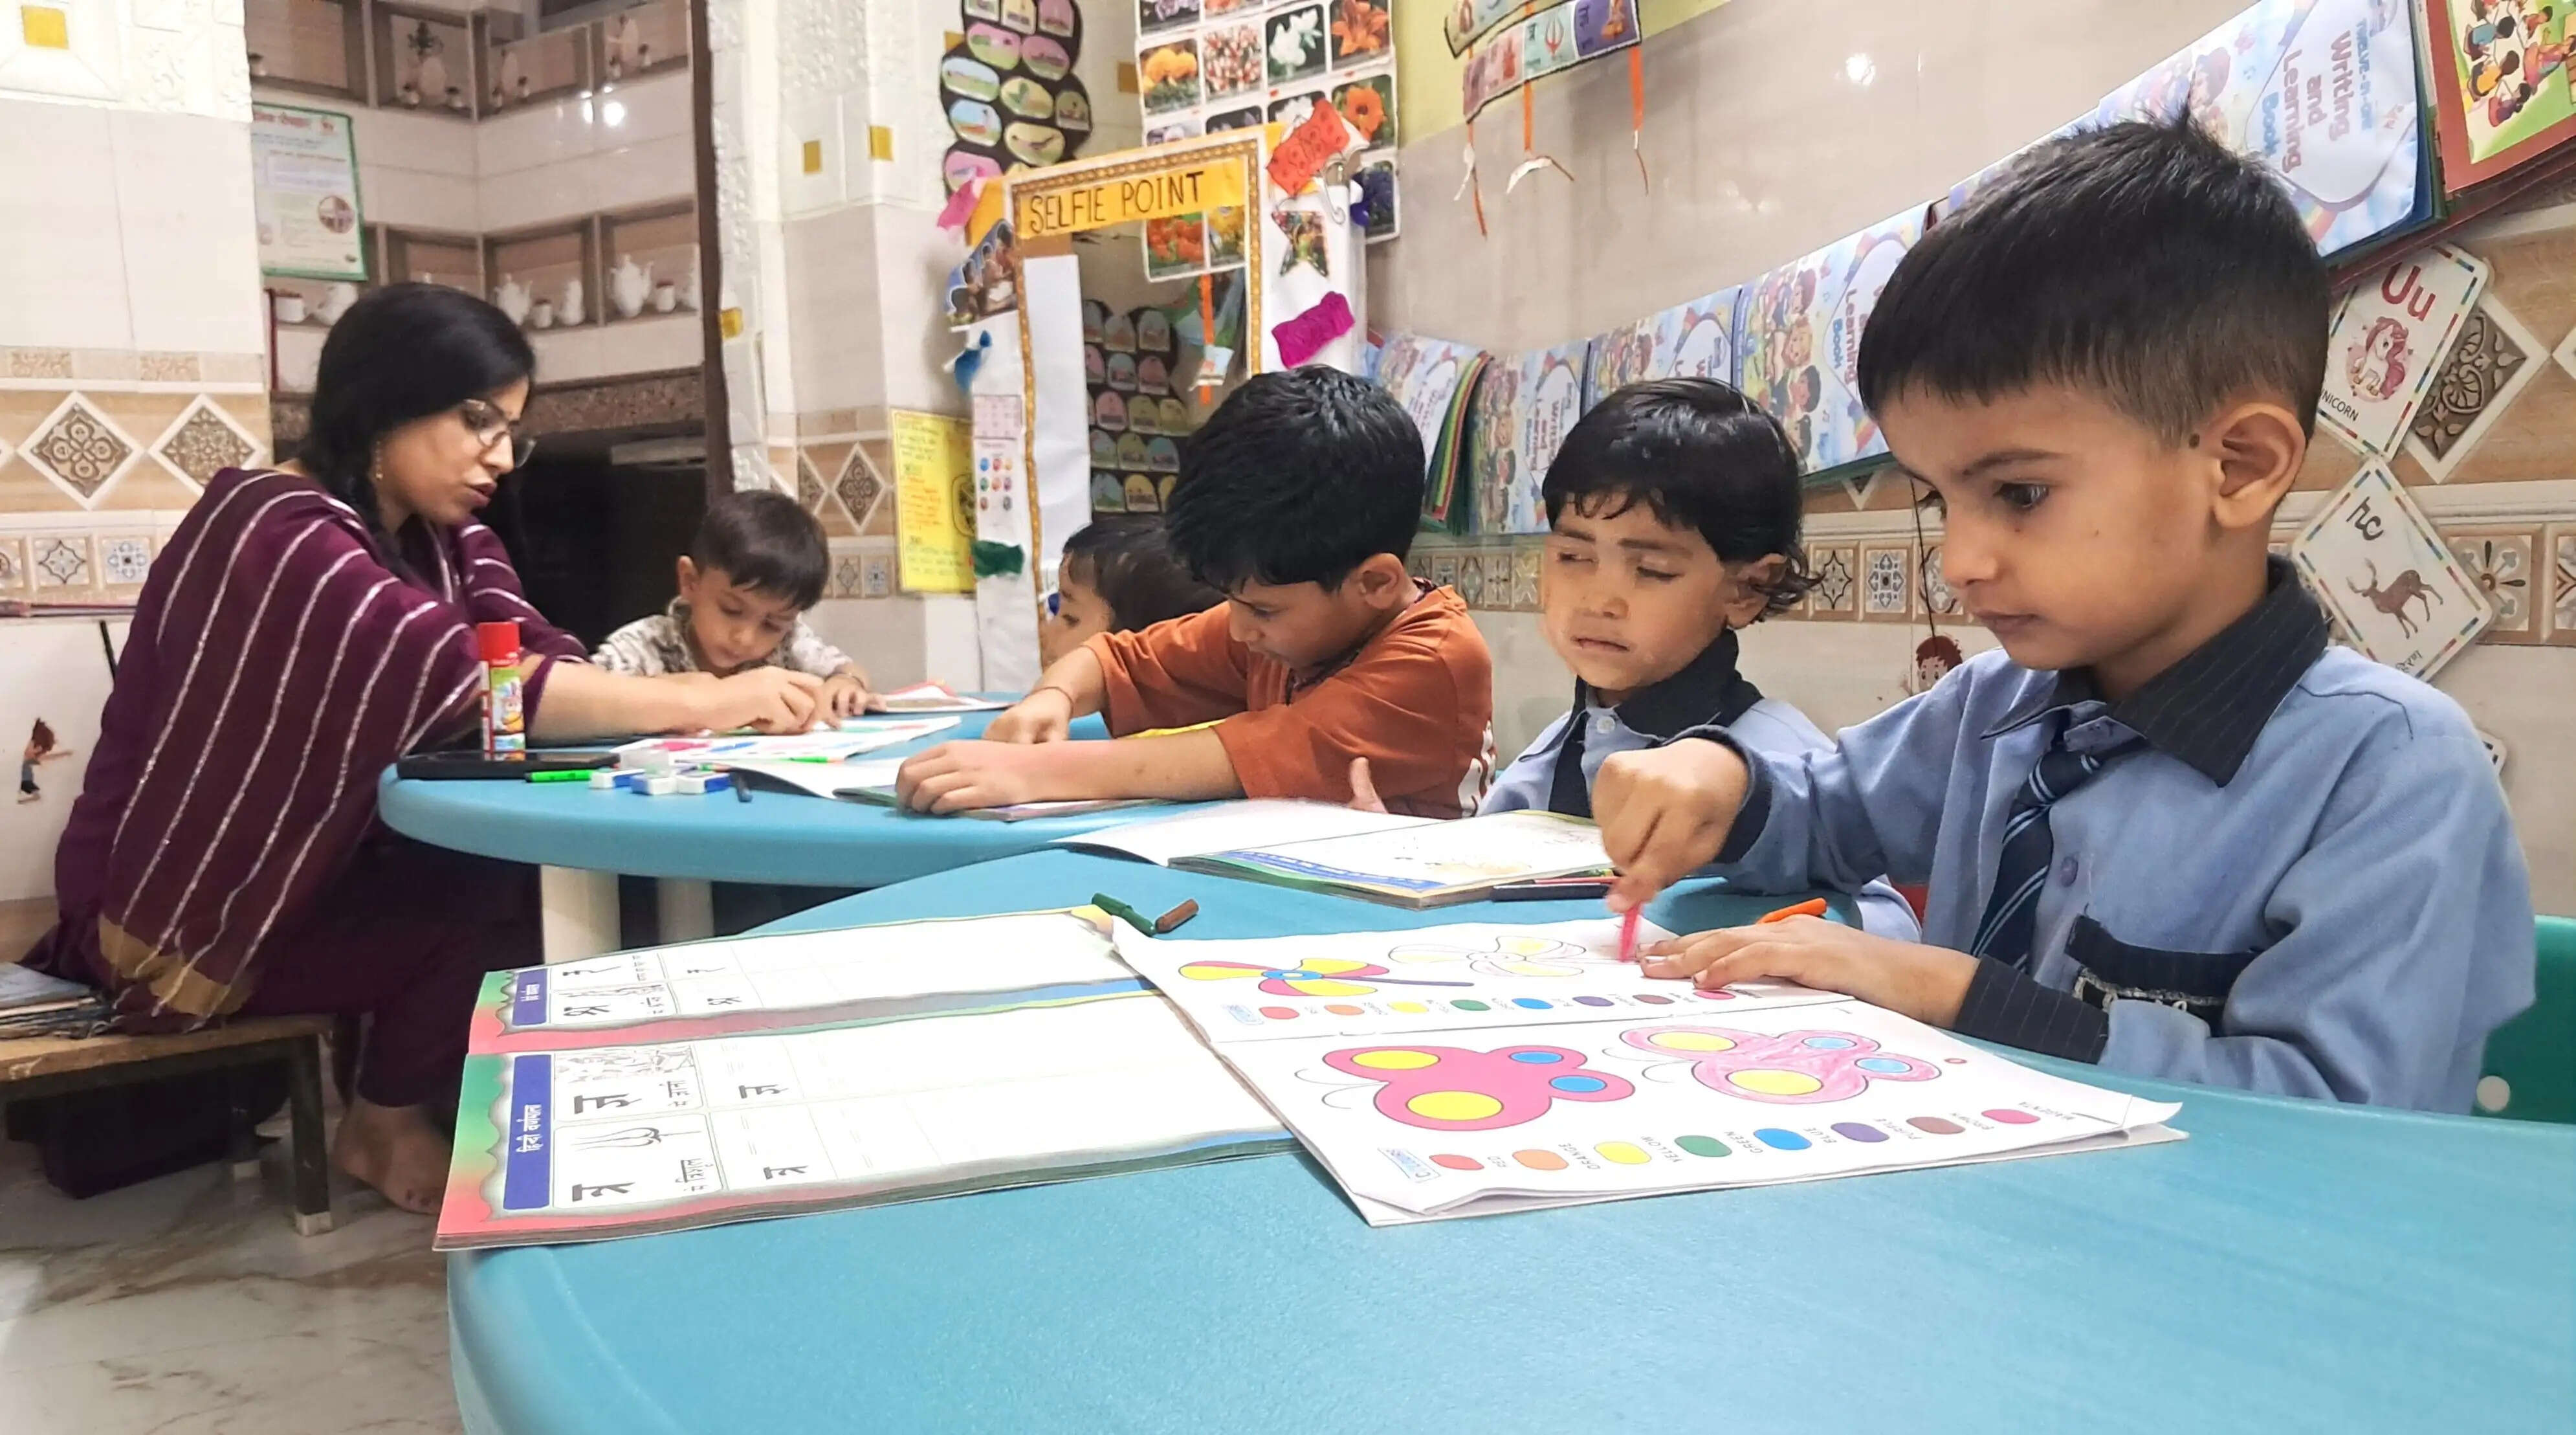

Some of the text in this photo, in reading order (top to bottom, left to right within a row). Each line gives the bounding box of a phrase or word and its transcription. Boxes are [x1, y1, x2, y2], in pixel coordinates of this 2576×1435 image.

[2283, 49, 2305, 173] Learning
[2307, 74, 2328, 126] and
[2329, 30, 2355, 142] Writing
[2260, 91, 2279, 158] Book
[1029, 171, 1205, 234] SELFIE POINT
[2381, 262, 2437, 322] Uu
[1833, 318, 1843, 370] Book
[1845, 288, 1858, 385] Learning
[2346, 496, 2384, 541] ह
[1558, 1142, 1601, 1170] ORANGE
[1640, 1135, 1683, 1163] YELLOW
[1723, 1131, 1764, 1154] GREEN
[1803, 1126, 1837, 1144] BLUE
[1487, 1155, 1506, 1168] RED
